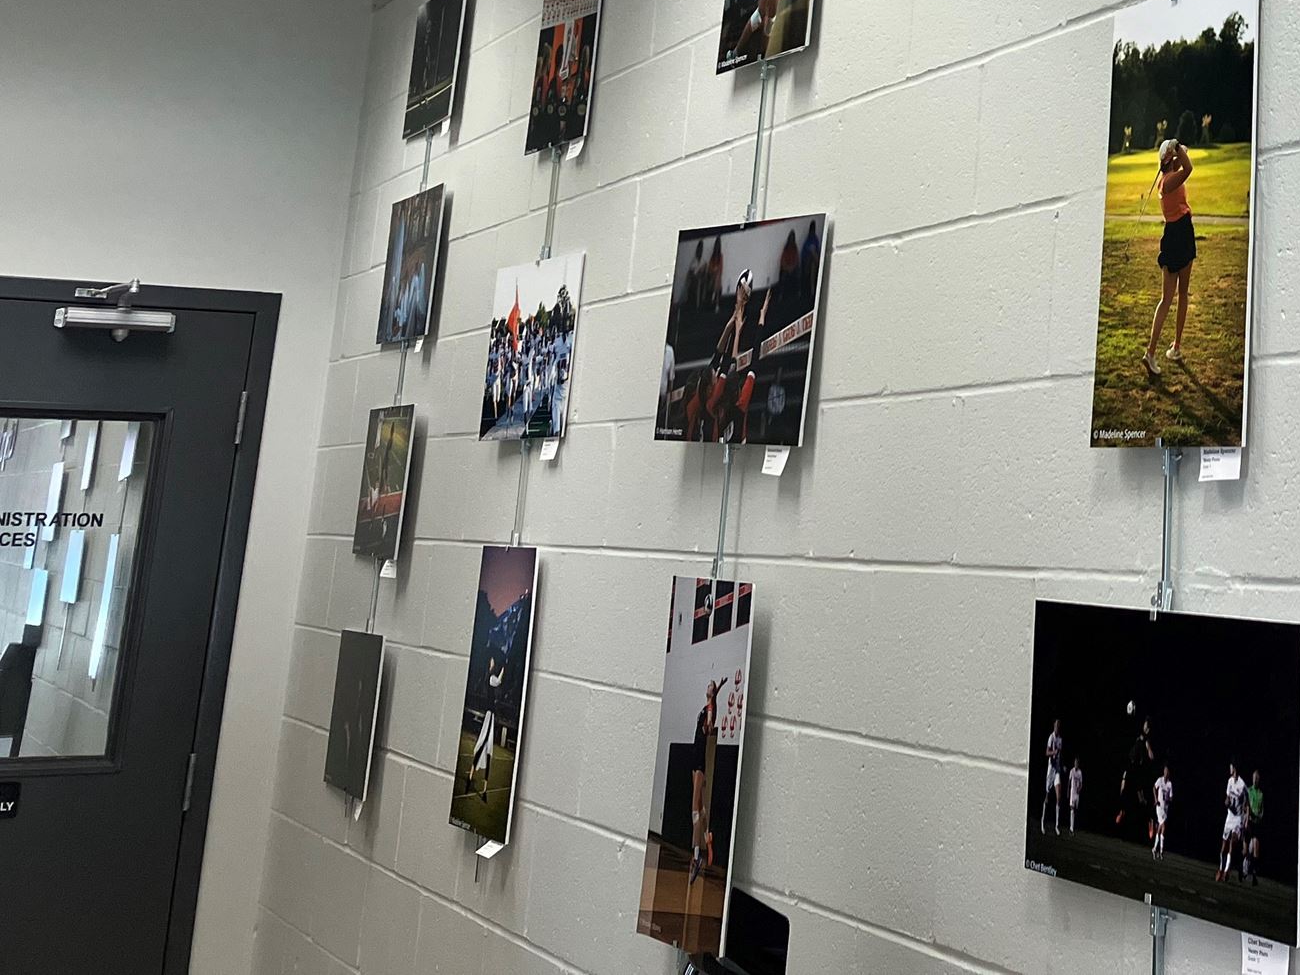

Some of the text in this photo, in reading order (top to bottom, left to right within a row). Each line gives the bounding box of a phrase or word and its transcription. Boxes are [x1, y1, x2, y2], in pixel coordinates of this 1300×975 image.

[1099, 429, 1124, 440] Madeline
[1124, 428, 1146, 441] Spencer
[0, 532, 36, 547] CES
[0, 801, 14, 811] LY
